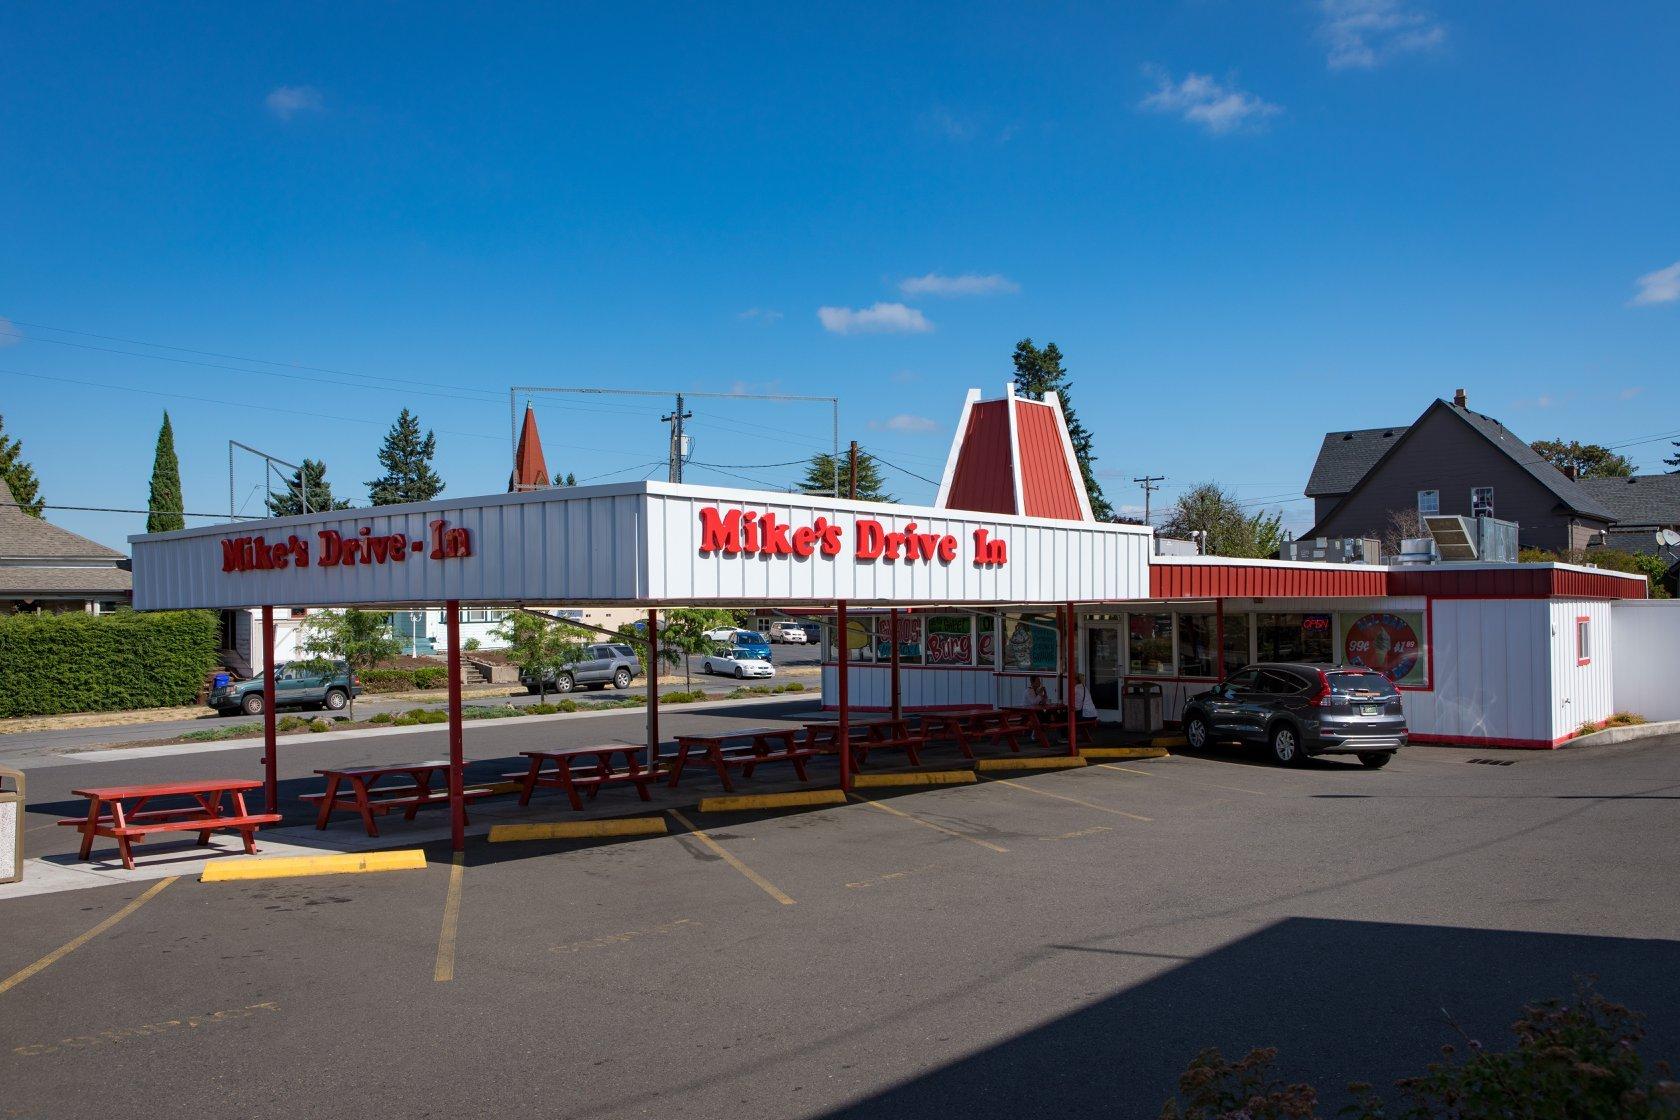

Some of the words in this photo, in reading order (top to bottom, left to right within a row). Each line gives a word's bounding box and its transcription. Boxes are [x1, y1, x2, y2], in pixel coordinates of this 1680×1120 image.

[221, 535, 309, 572] Mike's
[700, 506, 842, 557] Mike's
[854, 519, 958, 561] Drive
[973, 528, 1008, 566] In
[1303, 619, 1329, 630] OPEN
